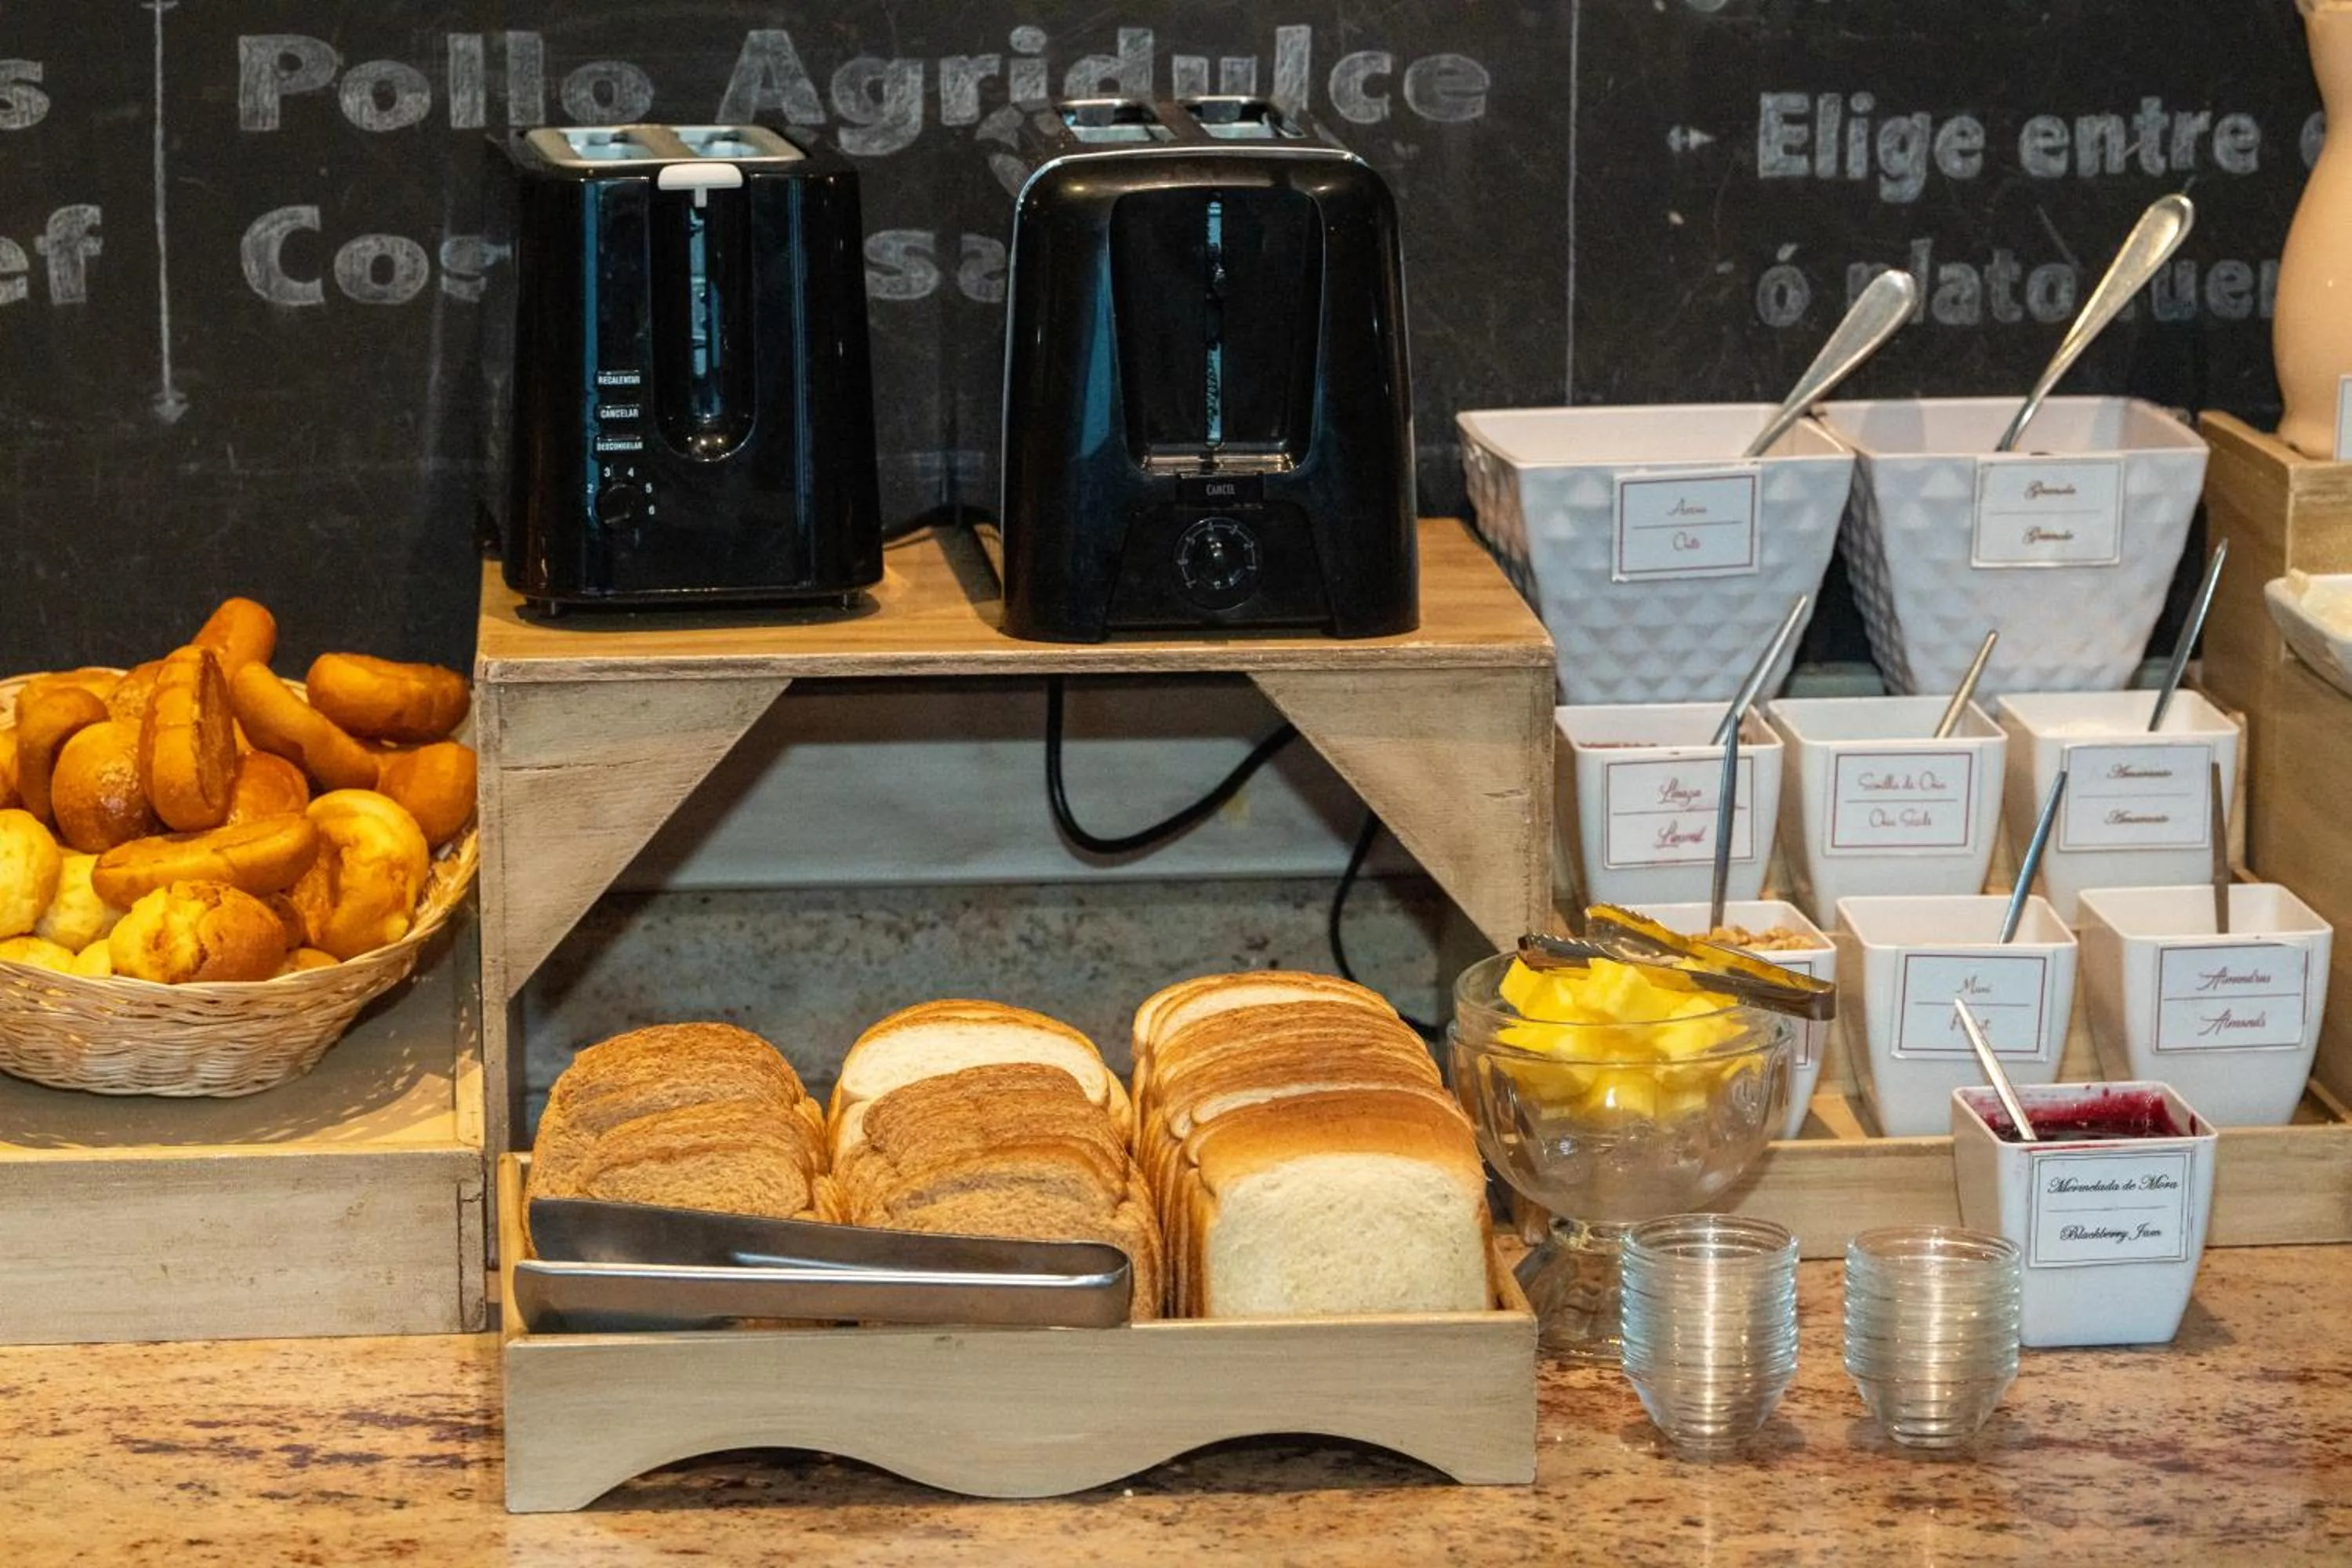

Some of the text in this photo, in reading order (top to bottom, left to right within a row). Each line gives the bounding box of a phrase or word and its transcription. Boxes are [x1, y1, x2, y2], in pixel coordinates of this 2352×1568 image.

[238, 24, 1491, 155] Pollo Agridulce
[1758, 92, 1987, 202] Elige
[2018, 96, 2263, 178] entre
[601, 408, 639, 419] CANCELAR
[2047, 1174, 2178, 1194] Mermelada de Mora
[2059, 1221, 2161, 1243] Blackberry Jam
